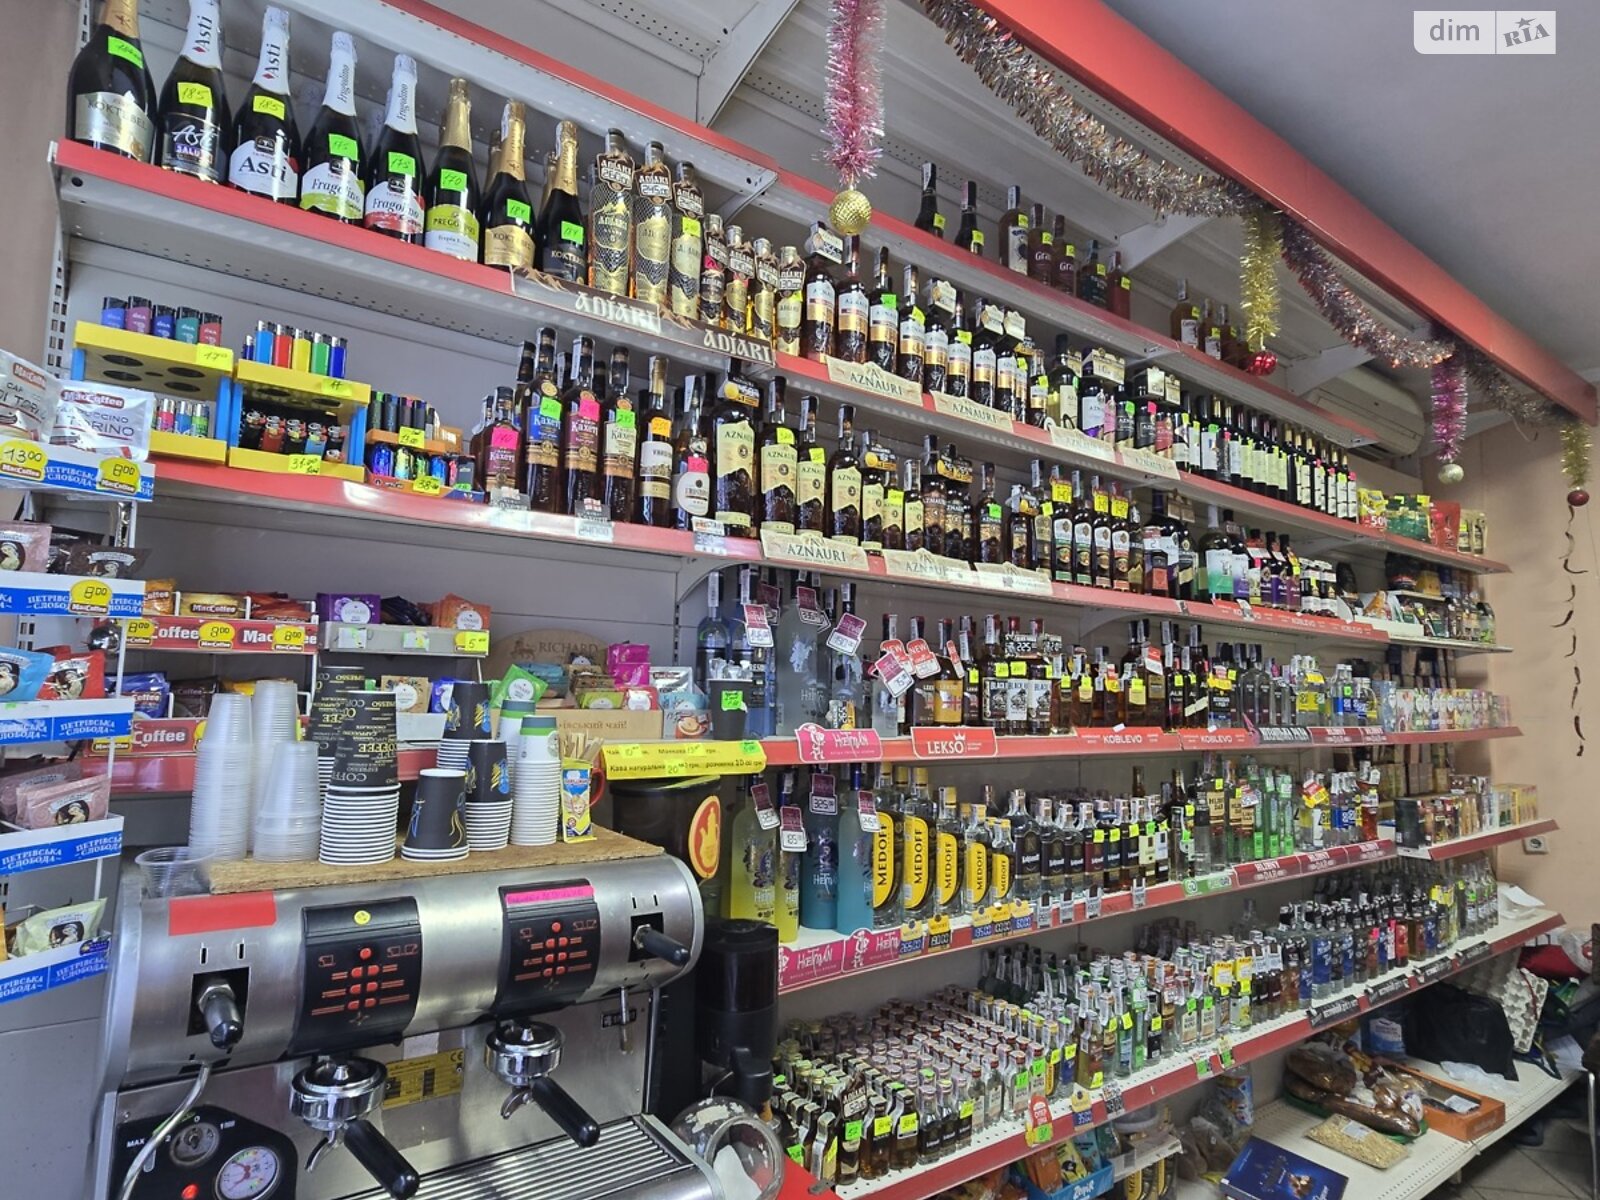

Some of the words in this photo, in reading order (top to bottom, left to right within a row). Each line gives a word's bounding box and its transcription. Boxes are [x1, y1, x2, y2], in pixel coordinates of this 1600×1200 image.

[196, 15, 213, 49] Asti
[265, 43, 281, 77] Asti
[238, 155, 287, 183] Asti
[850, 372, 903, 396] AZNAURI
[952, 401, 997, 424] AZNAURI
[786, 544, 846, 562] AZNAURI
[538, 641, 598, 655] RICHARD
[927, 740, 965, 755] LEKSO
[1103, 734, 1142, 744] KOBLEVO
[1200, 734, 1233, 743] KOBLEVO
[913, 827, 924, 885] MEDOFF
[944, 841, 953, 890] MEDOFF
[976, 849, 984, 891] MEDOFF
[1000, 860, 1008, 893] MEDOFF
[126, 1137, 145, 1148] MAX
